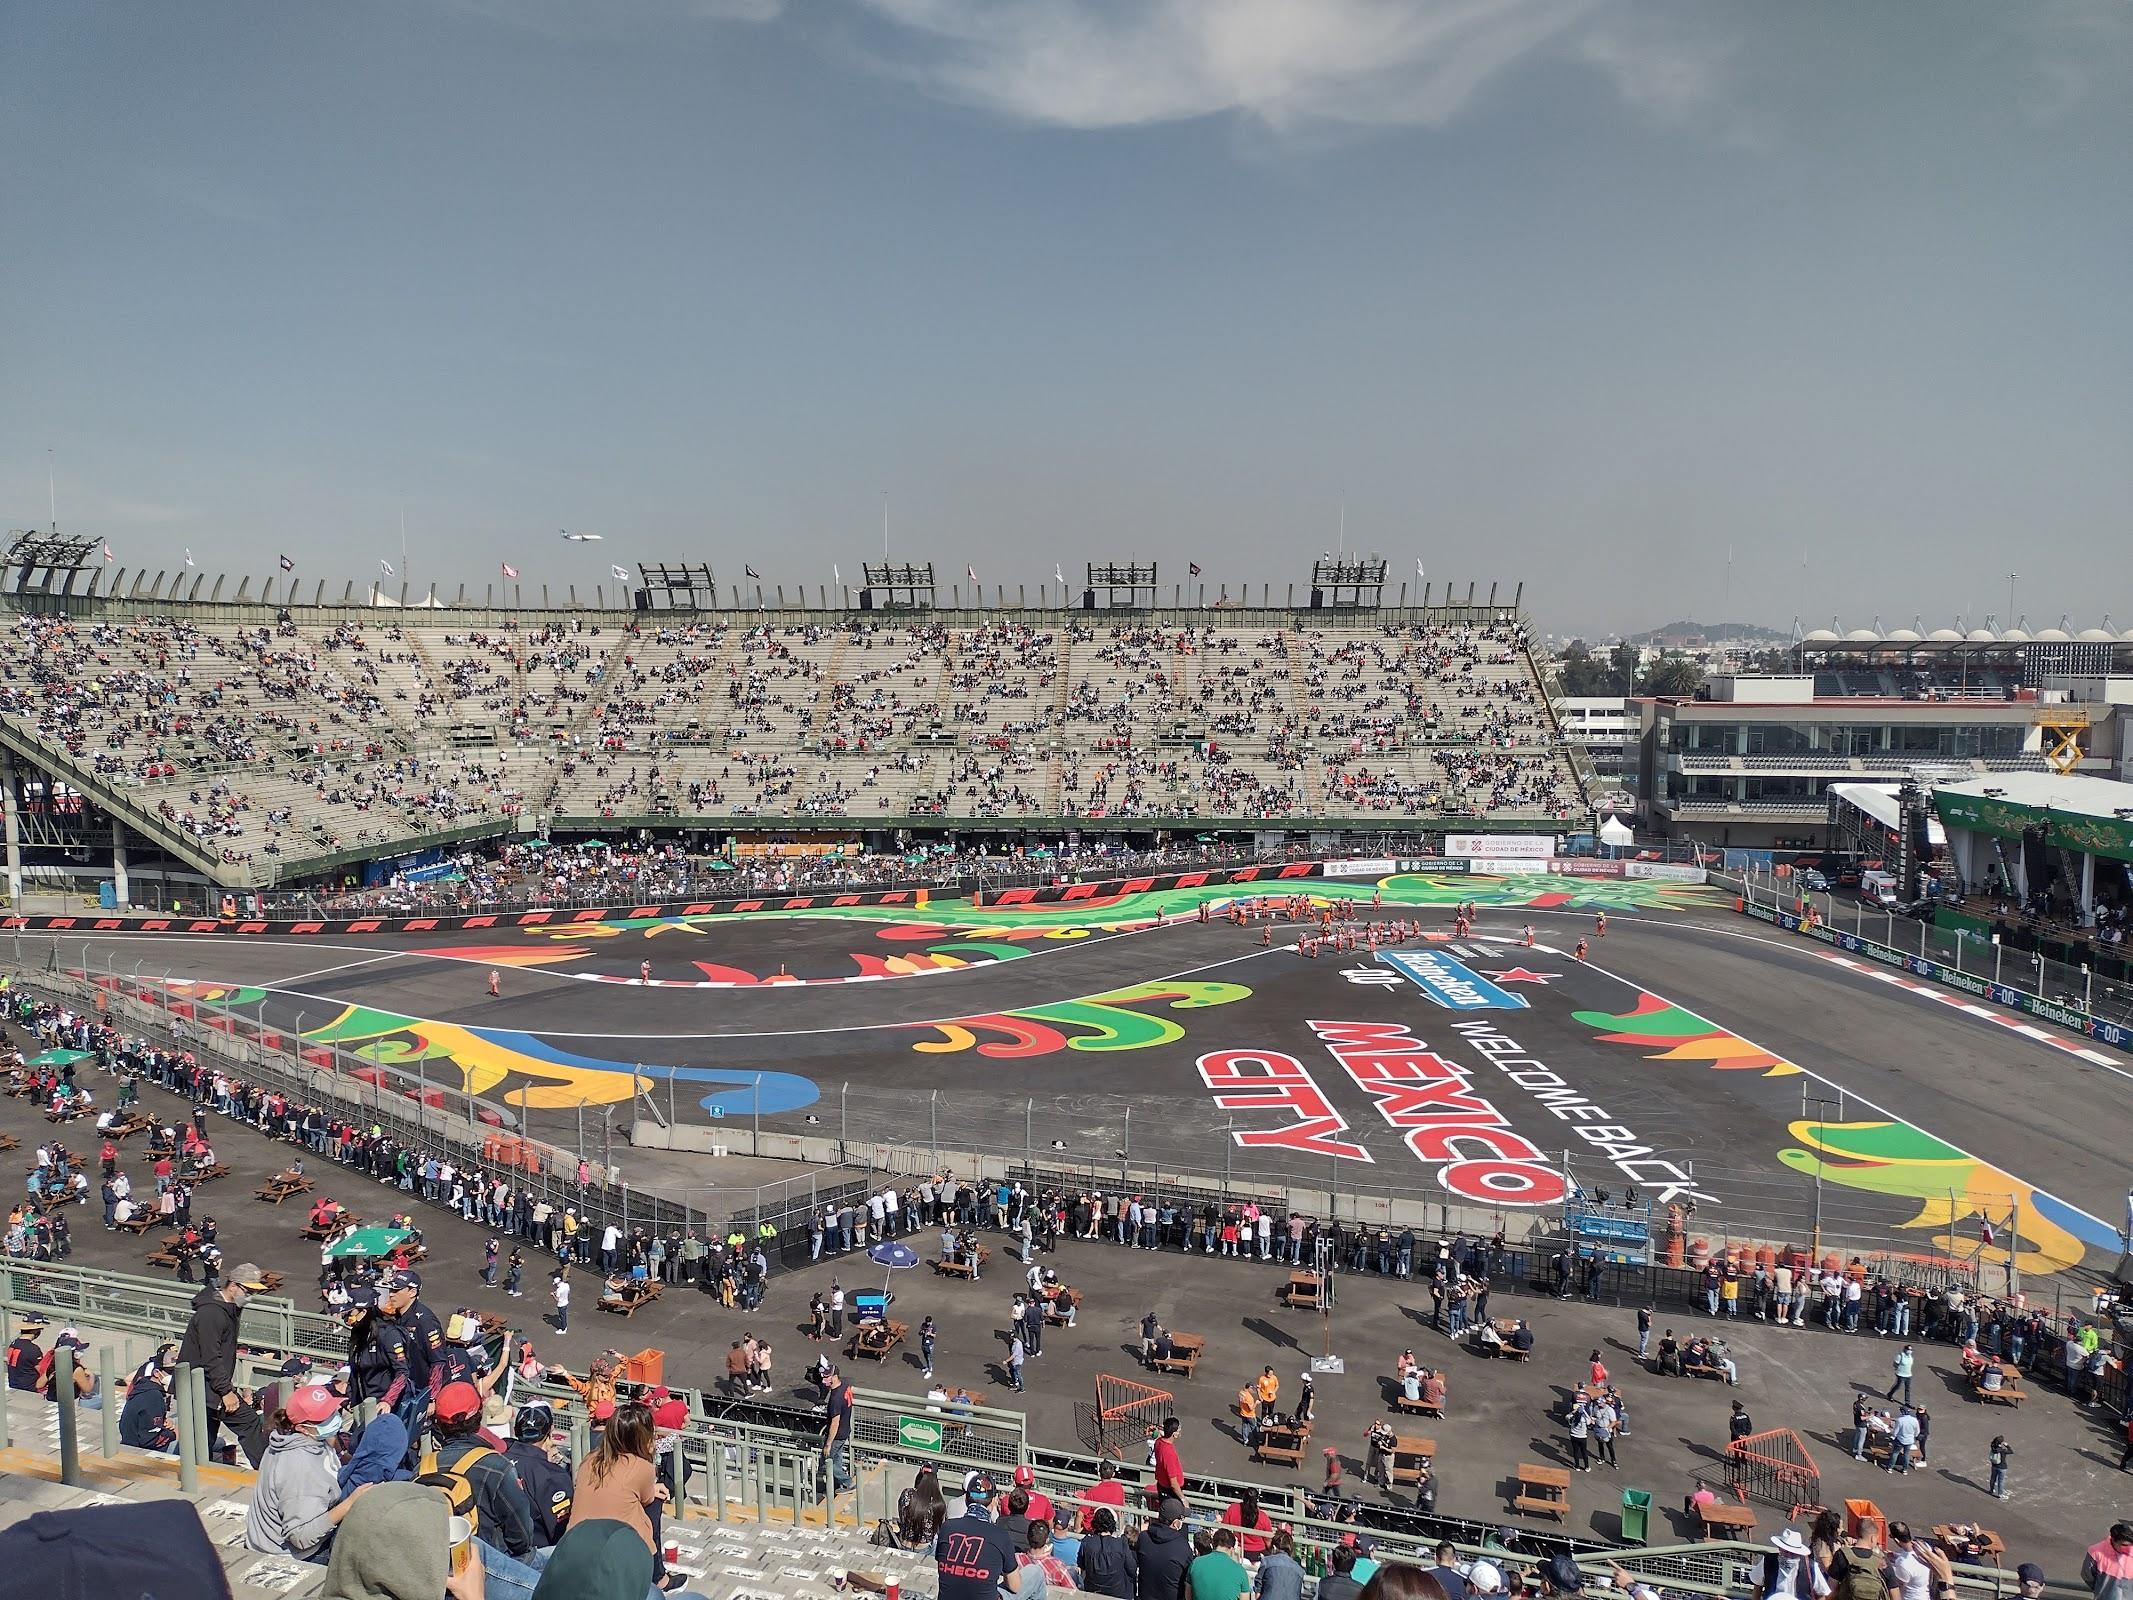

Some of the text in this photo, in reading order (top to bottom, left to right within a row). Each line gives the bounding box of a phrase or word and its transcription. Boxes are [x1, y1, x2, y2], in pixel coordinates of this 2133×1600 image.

[1747, 903, 1774, 922] Heineken
[1806, 927, 1834, 943] eineken
[1867, 943, 1903, 966] Heineken
[1391, 951, 1490, 1006] Heineken
[1941, 969, 1984, 995] Heineken
[2031, 999, 2082, 1030] Heineken
[1195, 1049, 1376, 1164] CITY
[1304, 1019, 1576, 1207] MÉXICO
[1450, 1020, 1722, 1204] WELCOME BACK
[946, 1532, 985, 1566] 11
